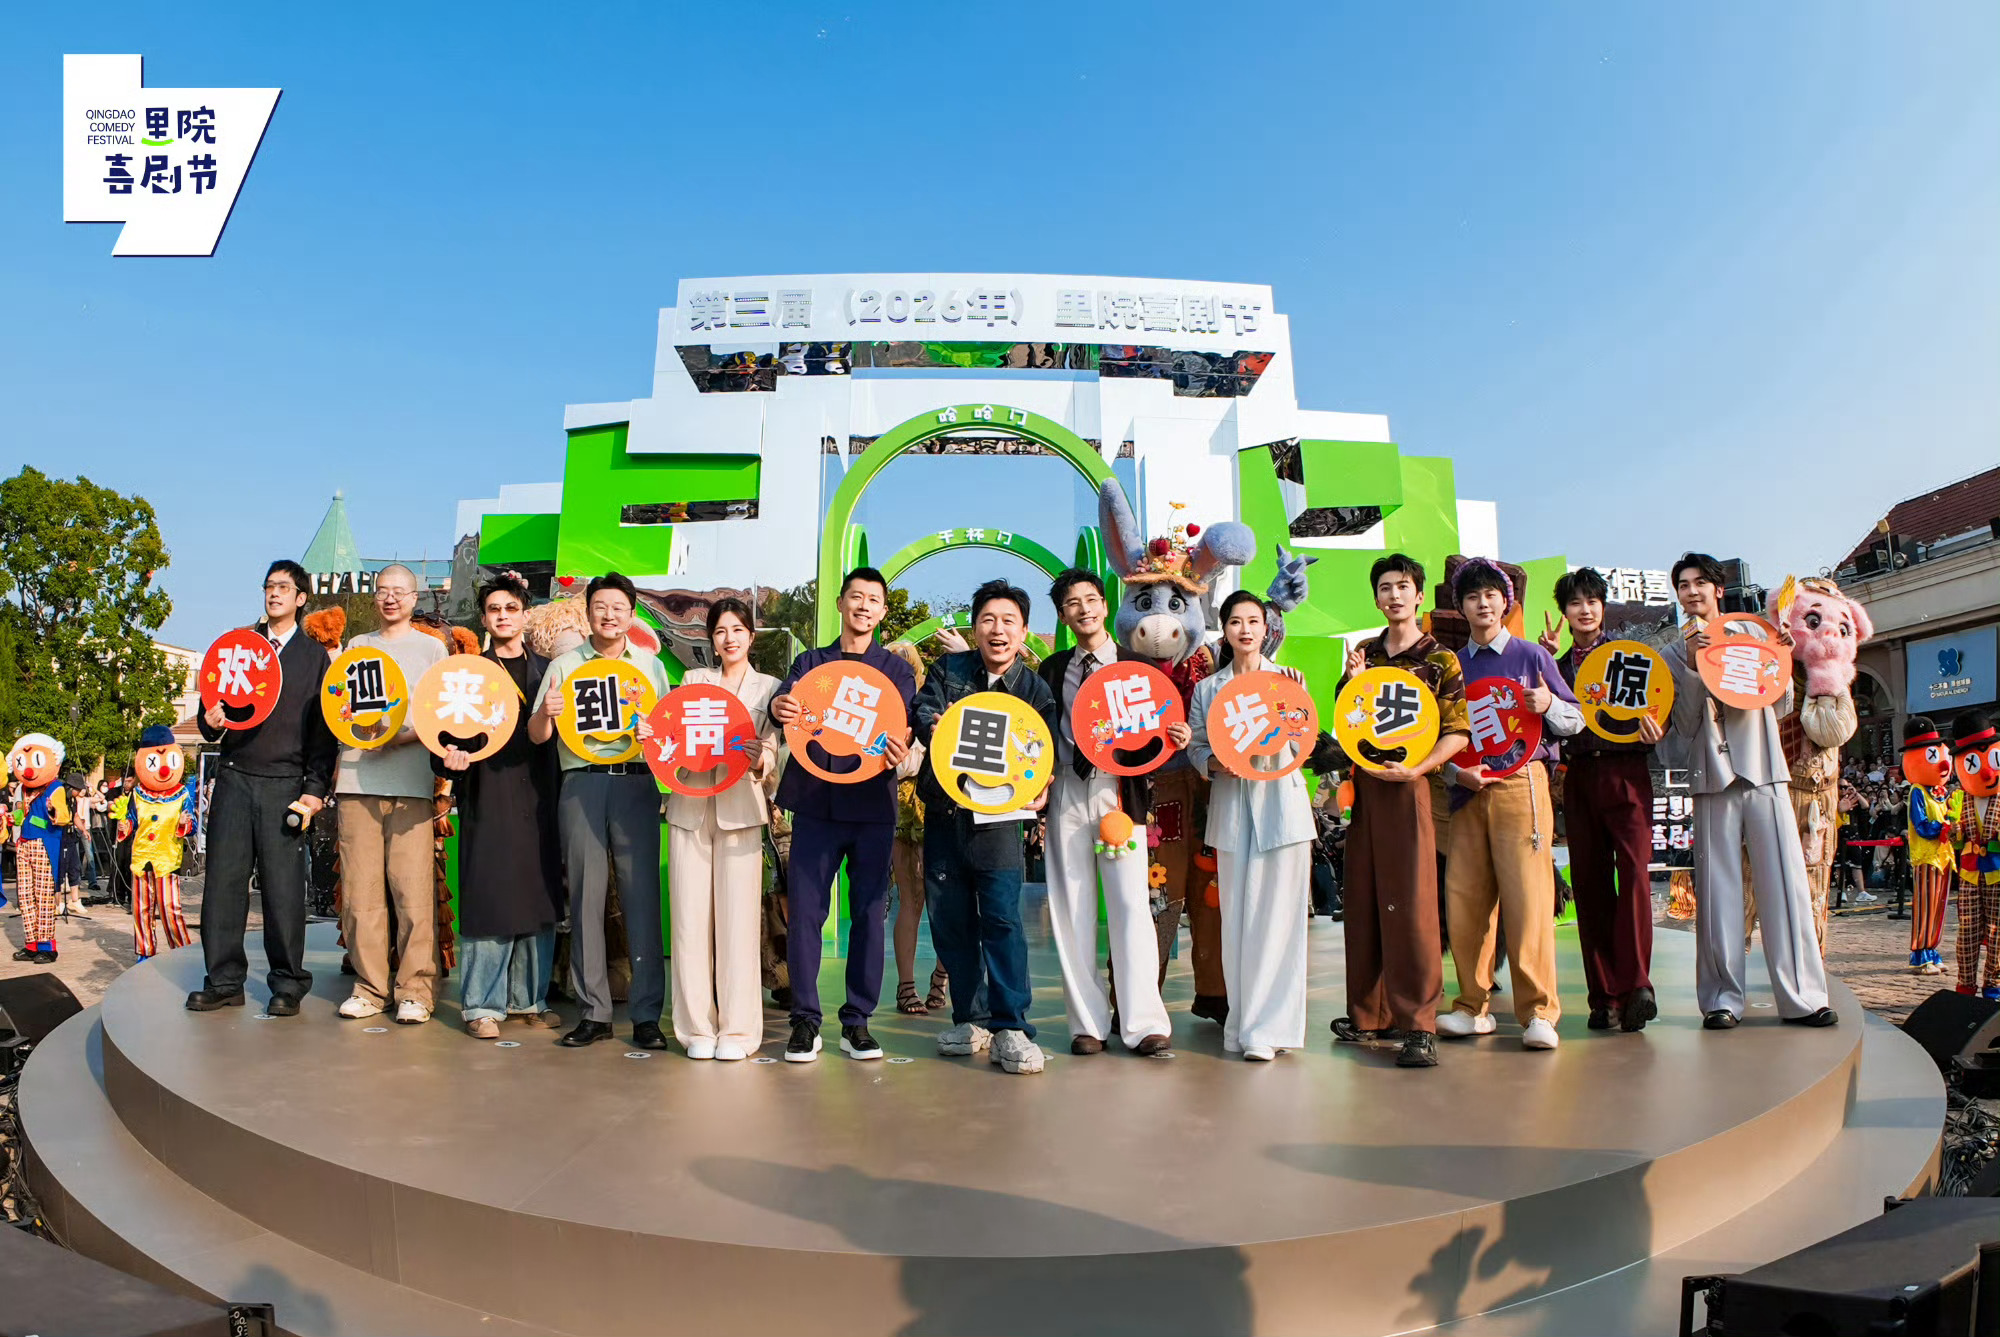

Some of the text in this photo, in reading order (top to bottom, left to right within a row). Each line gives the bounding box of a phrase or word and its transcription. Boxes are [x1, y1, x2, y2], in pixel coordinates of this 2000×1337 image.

[937, 404, 1028, 426] 哈哈门
[1598, 567, 1671, 607] 惊喜
[216, 644, 254, 697] 欢
[346, 659, 388, 713] 迎
[434, 668, 486, 726] 来
[1604, 651, 1652, 708] 惊
[1719, 645, 1763, 696] 喜
[574, 675, 621, 733] 到
[681, 697, 730, 756] 青
[824, 675, 883, 745] 岛
[1103, 673, 1161, 739] 院
[1223, 692, 1271, 754] 步
[1374, 682, 1420, 736] 步
[1467, 693, 1507, 753] 有
[951, 706, 1008, 774] 里
[1651, 824, 1694, 850] 喜剧
